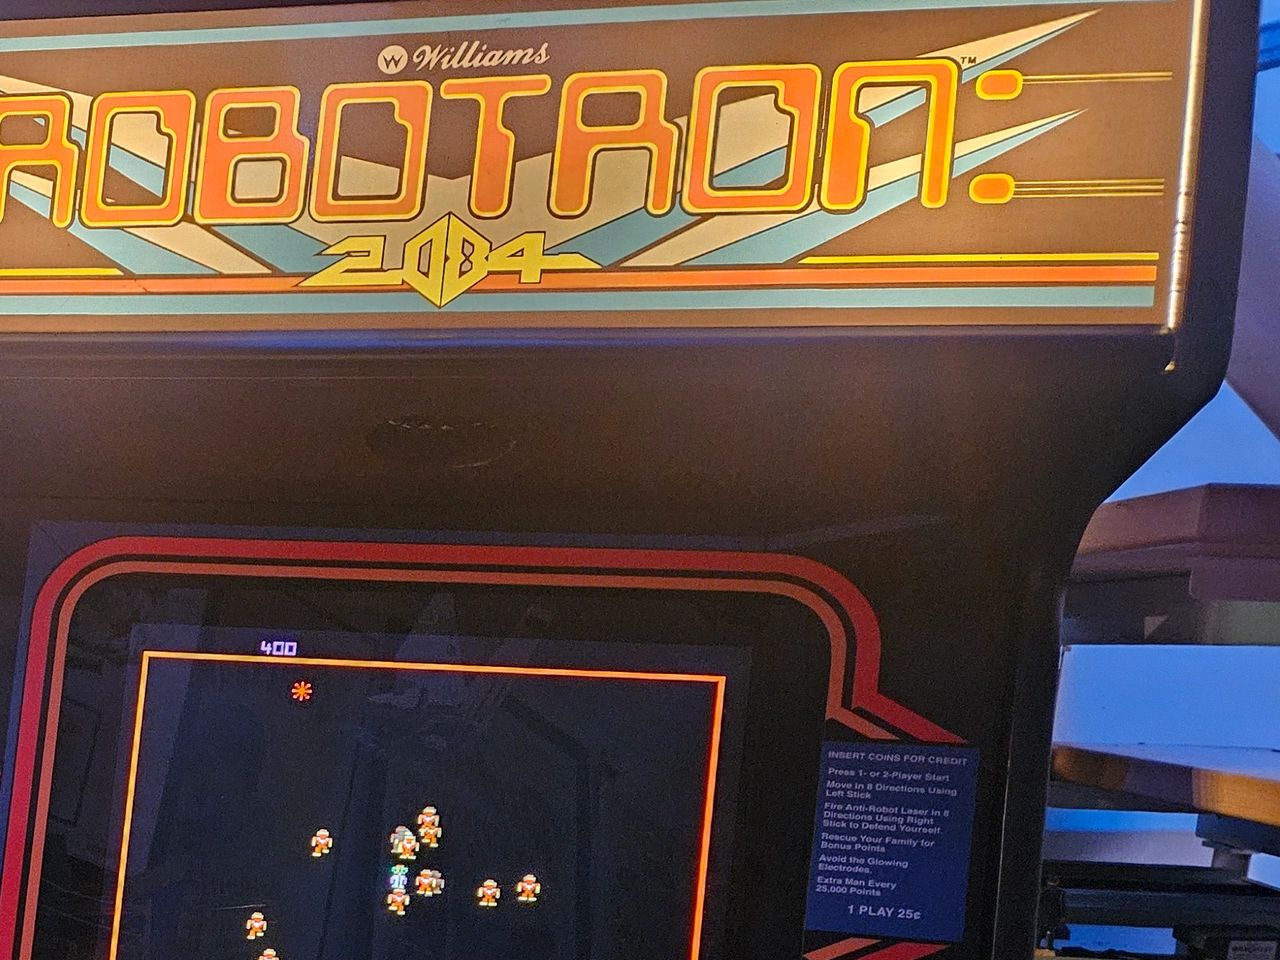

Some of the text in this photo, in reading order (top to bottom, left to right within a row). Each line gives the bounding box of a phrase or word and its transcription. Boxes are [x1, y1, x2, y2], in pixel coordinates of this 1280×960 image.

[412, 40, 551, 72] Williams
[295, 211, 603, 309] 2084
[260, 640, 298, 657] 400
[828, 751, 968, 766] INSERT COINS FOR CREDIT
[828, 767, 856, 776] Press
[882, 770, 922, 781] 2-Player
[925, 772, 951, 782] Start
[825, 789, 872, 800] Left Stick
[826, 780, 852, 789] Move
[875, 783, 926, 794] Directions
[928, 786, 958, 797] Using
[824, 802, 844, 811] Fire
[845, 803, 898, 814] Anti-Robot
[901, 806, 929, 816] Laser
[822, 819, 847, 828] Stick
[849, 821, 859, 829] to
[861, 822, 897, 832] Defend
[823, 810, 934, 826] Directions Using Right
[820, 841, 886, 853] Bonus Points
[821, 832, 936, 848] Rescue Your Family for
[818, 853, 909, 869] Avoid the Glowing
[815, 884, 882, 897] 25,000 Points
[816, 875, 898, 891] Extra Man Every
[847, 904, 855, 915] 1
[858, 904, 895, 918] PLAY
